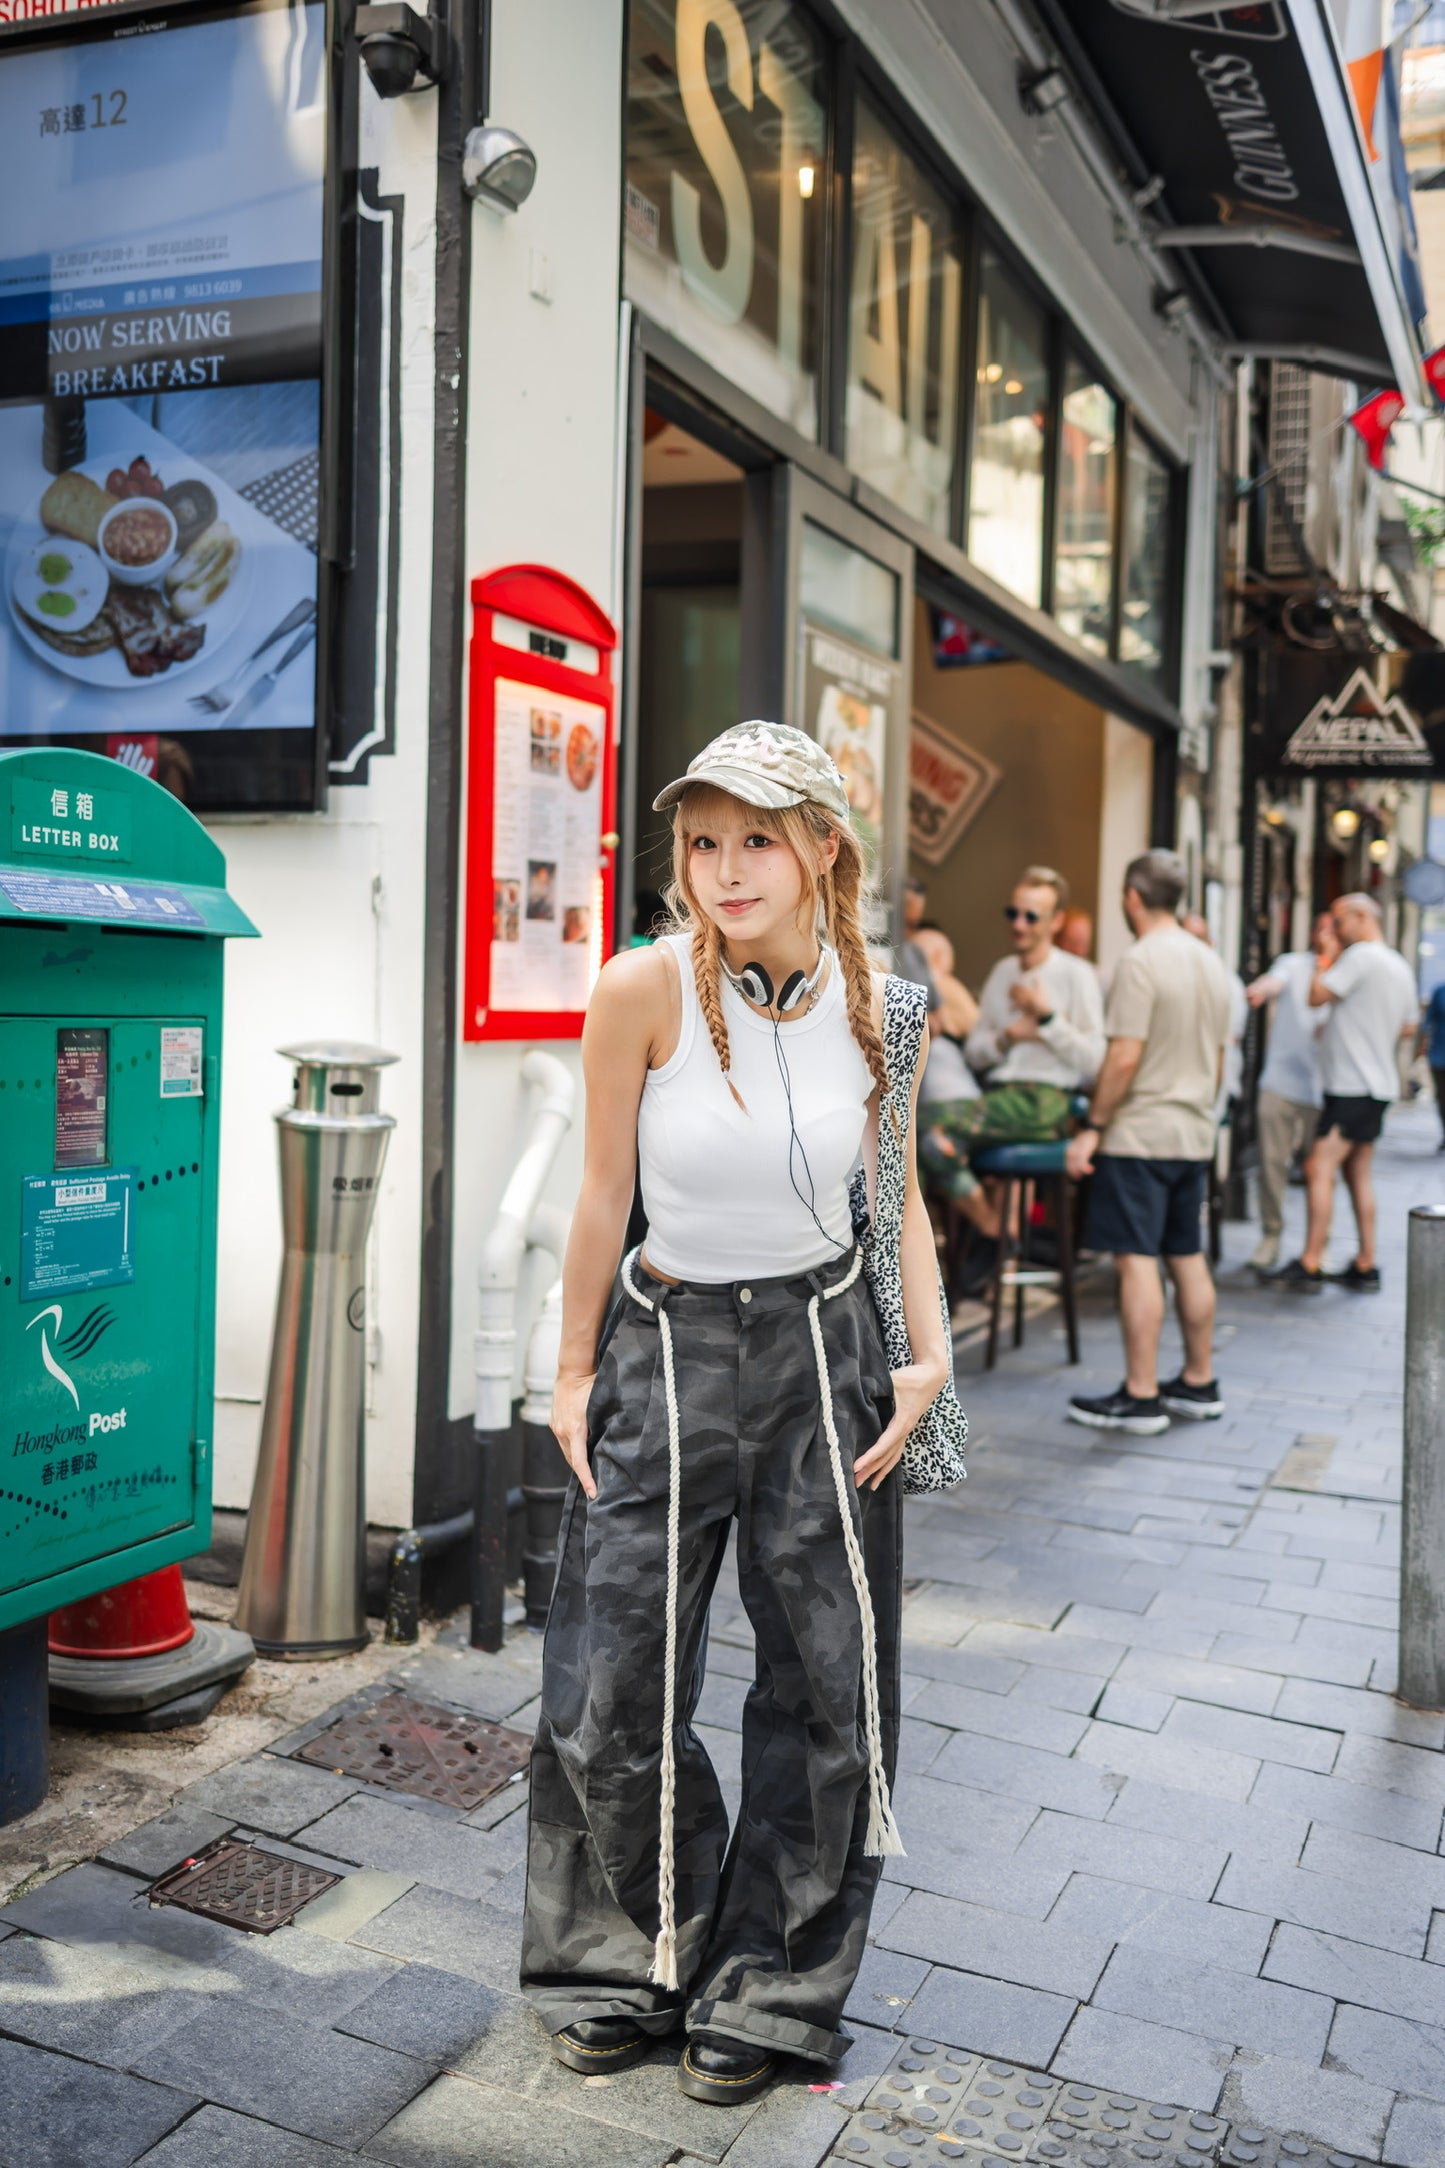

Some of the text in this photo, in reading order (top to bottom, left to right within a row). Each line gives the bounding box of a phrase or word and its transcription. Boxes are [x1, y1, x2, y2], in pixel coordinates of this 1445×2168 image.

[1190, 49, 1299, 200] GUINNESS
[48, 310, 232, 354] NOW SERVING
[54, 355, 226, 397] BREAKFAST
[50, 788, 93, 820] 信箱
[22, 824, 119, 852] LETTER BOX
[13, 1407, 127, 1457] Hongkong Post
[41, 1450, 98, 1486] 香港郵政
